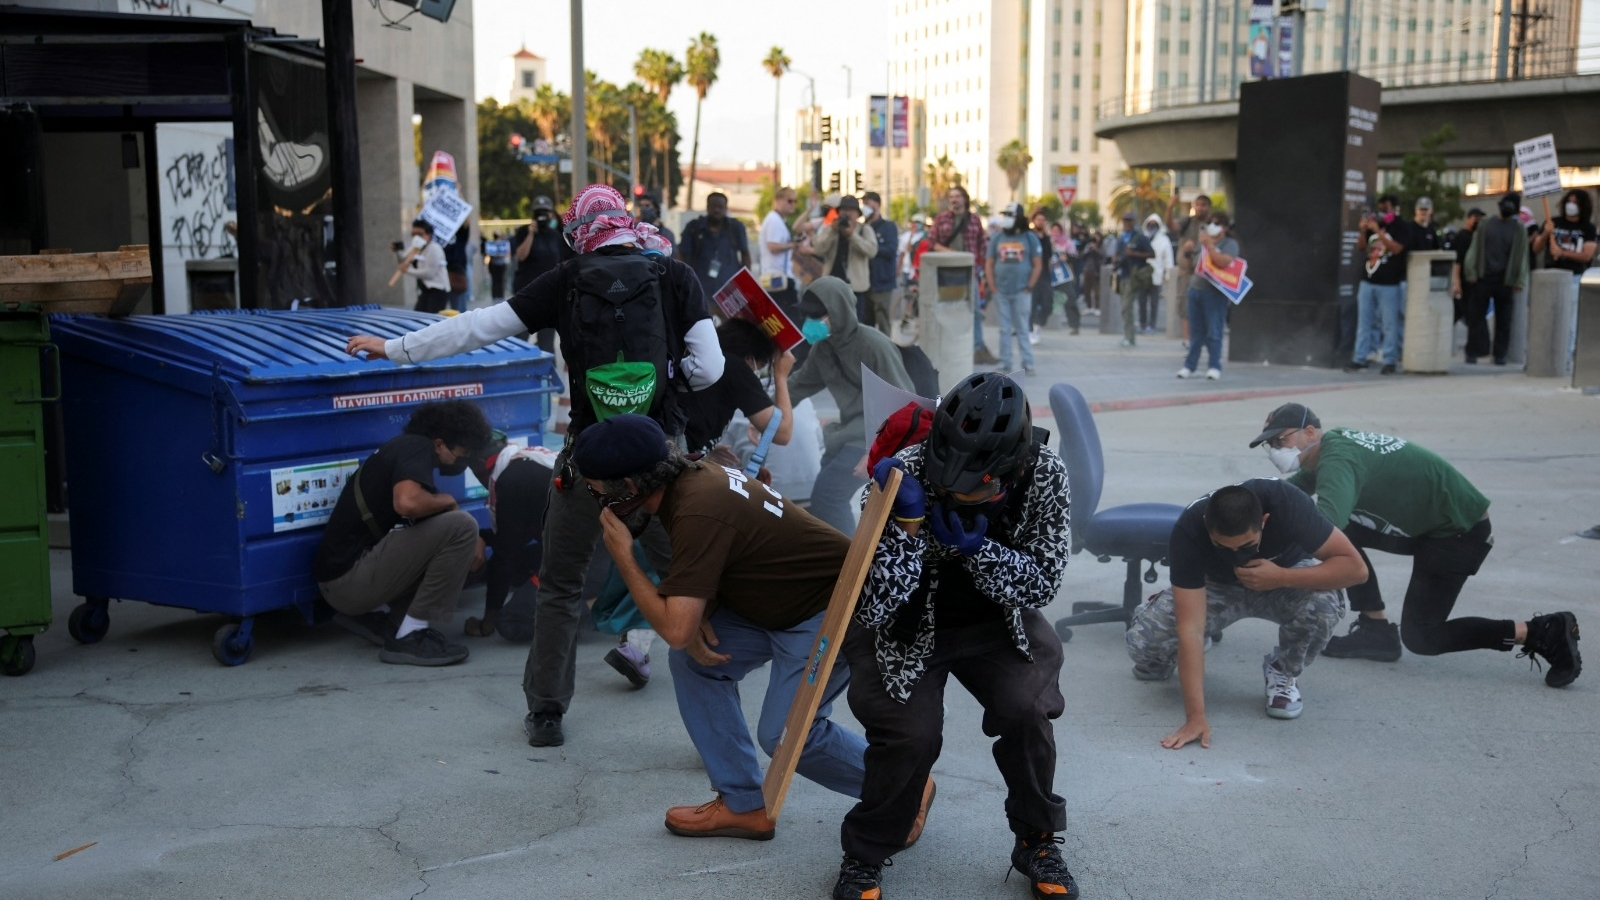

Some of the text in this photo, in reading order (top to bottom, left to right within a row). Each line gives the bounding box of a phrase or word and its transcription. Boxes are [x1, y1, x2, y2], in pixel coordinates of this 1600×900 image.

[1517, 144, 1535, 155] STOP
[1522, 172, 1540, 182] STOP
[336, 396, 393, 409] MAXIMUM
